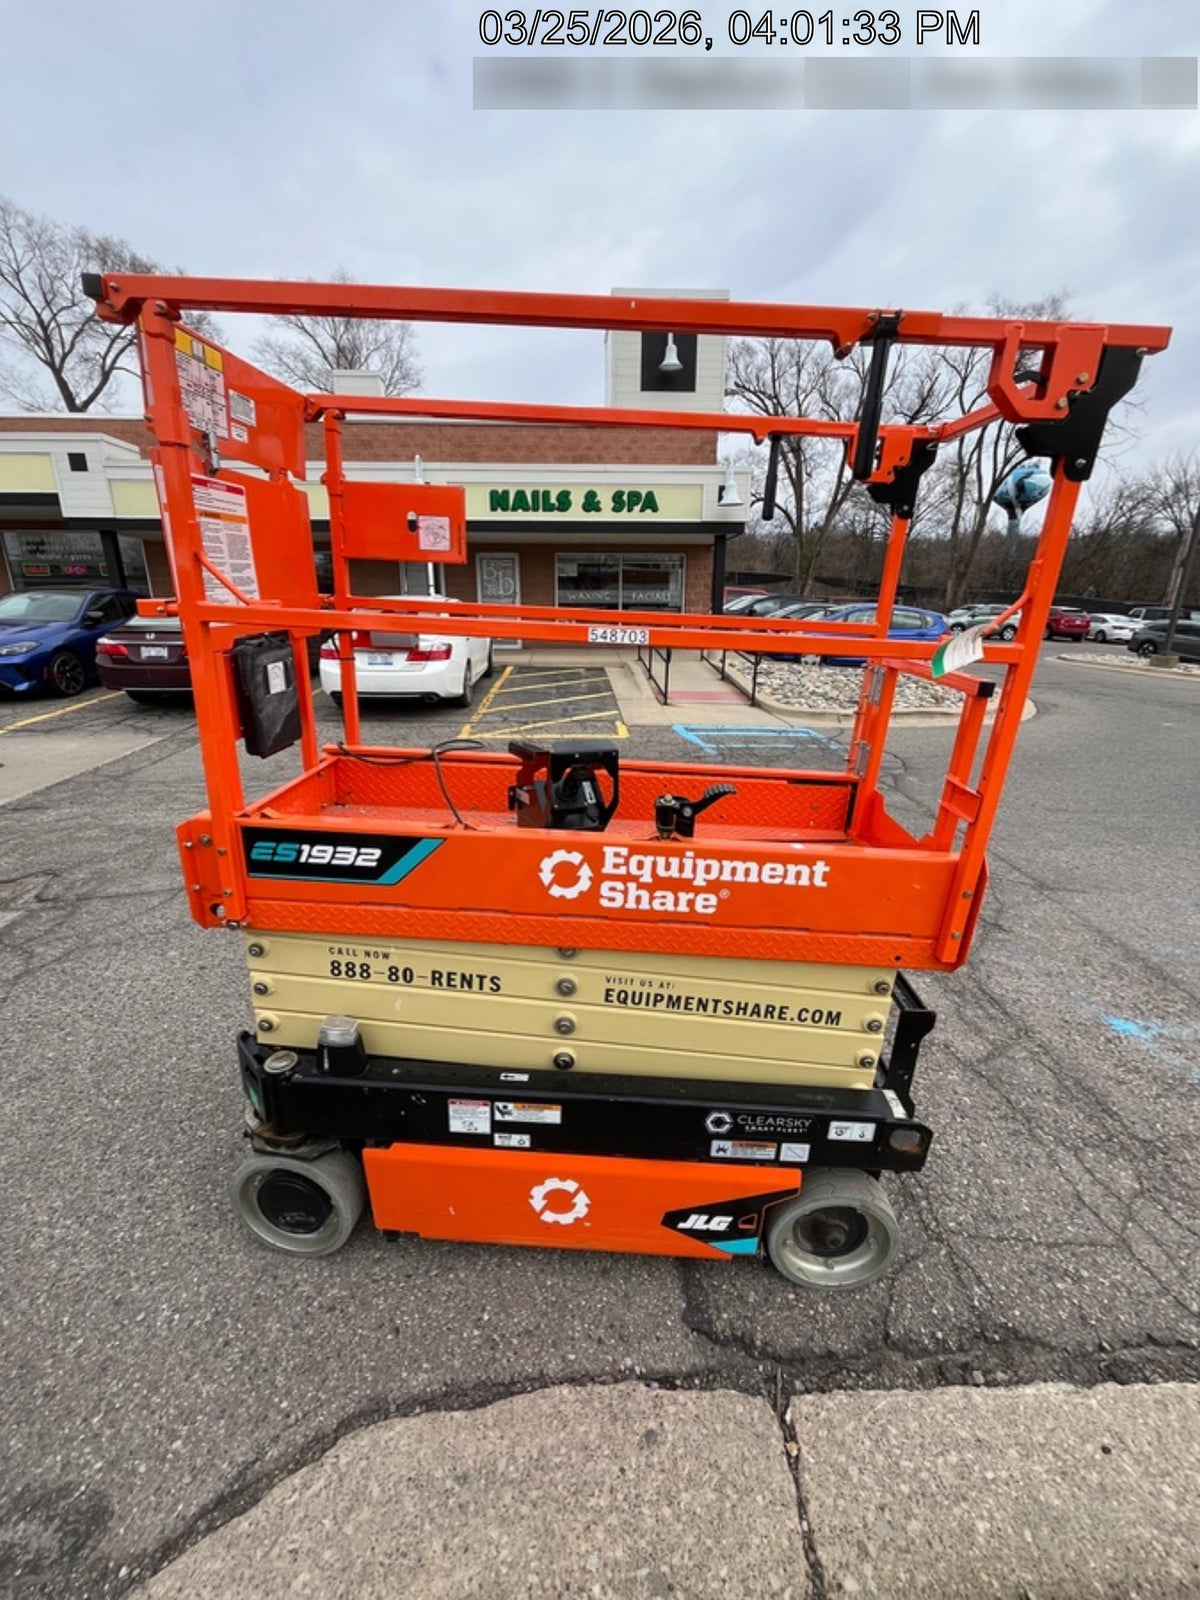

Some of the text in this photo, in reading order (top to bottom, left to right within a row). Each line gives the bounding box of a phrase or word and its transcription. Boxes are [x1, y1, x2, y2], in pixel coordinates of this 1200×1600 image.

[489, 489, 659, 513] NAILS & SPA
[589, 628, 648, 644] 548703
[250, 841, 382, 867] ES1932
[600, 845, 831, 888] Equipment
[327, 946, 391, 961] CALL NOW
[329, 959, 502, 993] 888-80-RENTS
[604, 976, 676, 990] VISIT US AT:
[603, 987, 843, 1027] EQUIPMENTSHARE.COM
[736, 1114, 813, 1130] CLEARSKY
[677, 1213, 734, 1232] JLG
